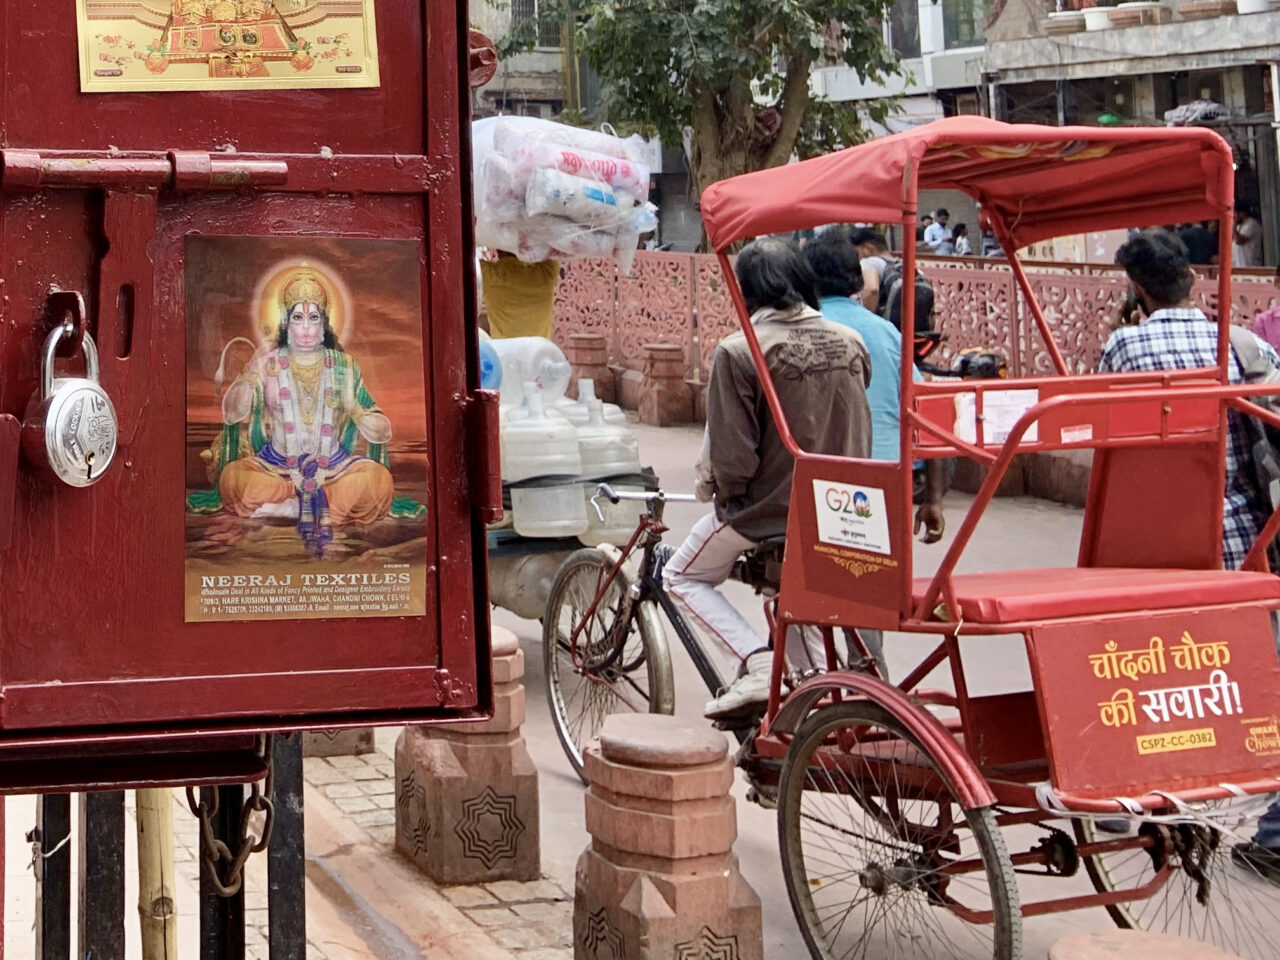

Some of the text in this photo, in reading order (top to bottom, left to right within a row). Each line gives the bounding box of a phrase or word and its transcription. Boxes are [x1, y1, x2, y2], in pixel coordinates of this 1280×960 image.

[201, 573, 410, 587] NEERAJ TEXTILES
[230, 587, 243, 595] Deal
[251, 587, 259, 595] All
[260, 587, 276, 595] Kinds
[284, 587, 300, 595] Fancy
[302, 586, 322, 594] Printed
[334, 586, 359, 594] Designer
[360, 585, 391, 593] Embroidery
[222, 597, 240, 605] HARE
[332, 594, 360, 603] CHANDNI
[1088, 631, 1231, 681] चाँदनी चौक
[1097, 669, 1244, 728] की सवारी!
[1140, 731, 1214, 751] CSPZ-CC-0382
